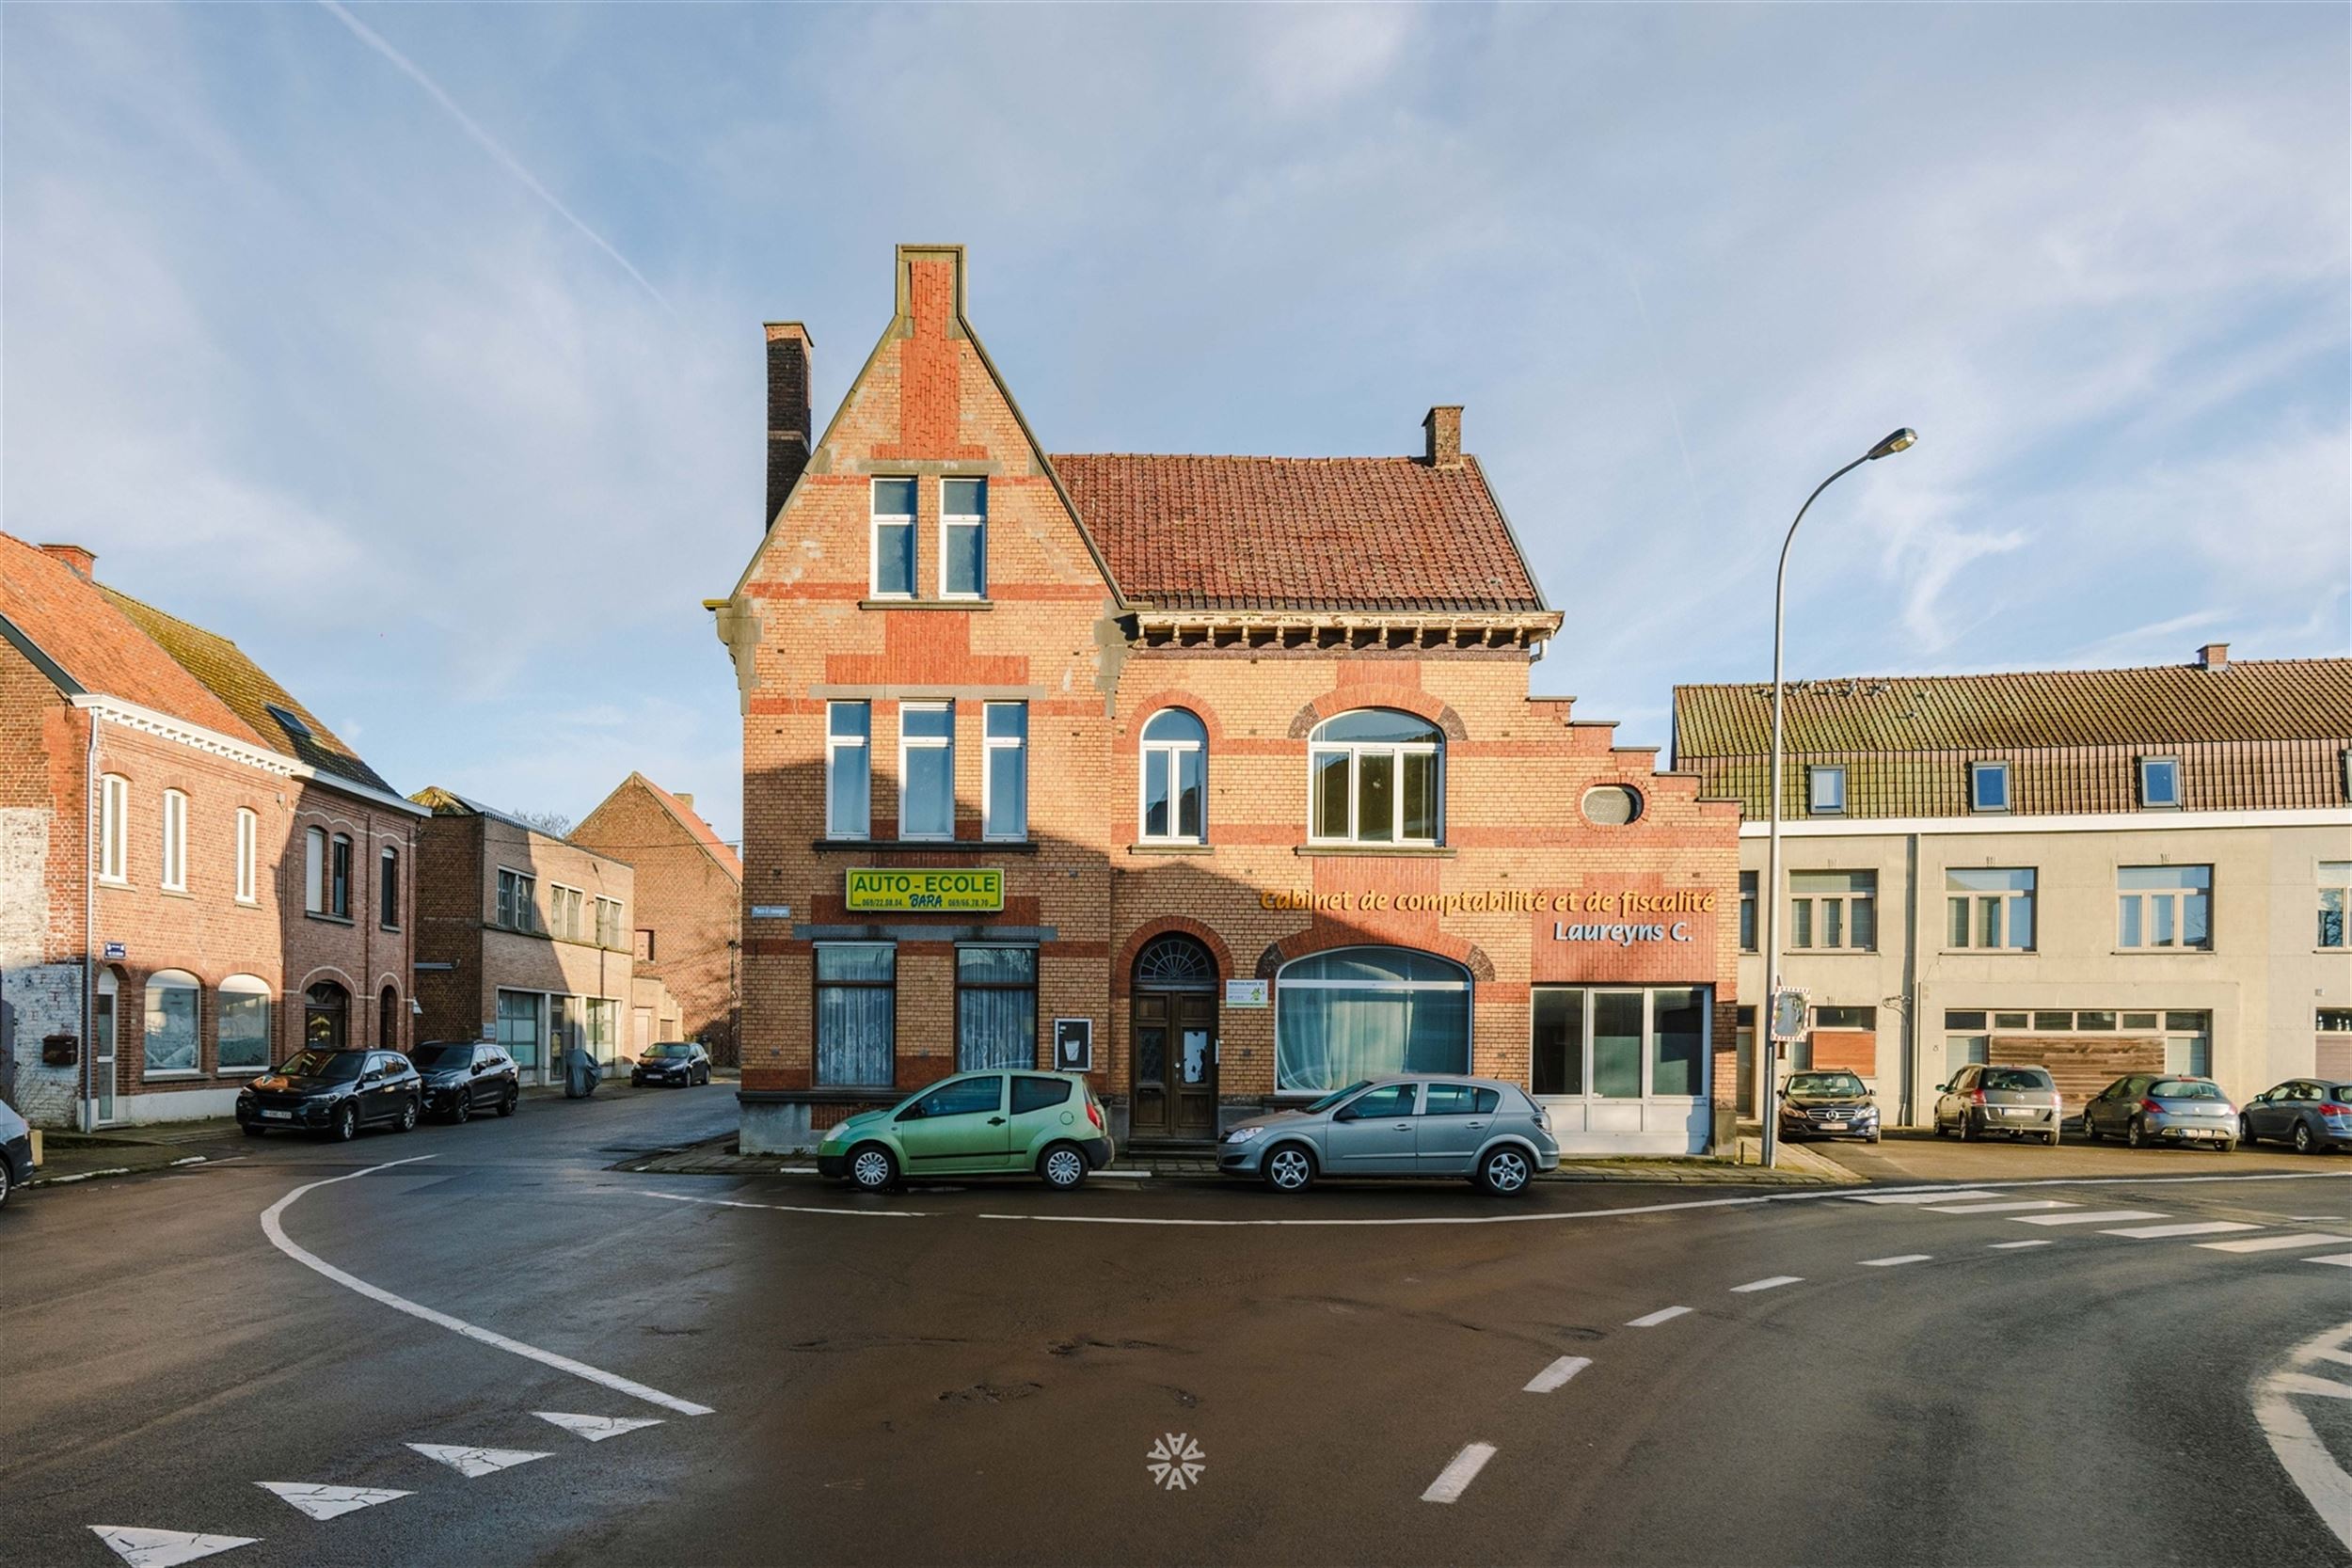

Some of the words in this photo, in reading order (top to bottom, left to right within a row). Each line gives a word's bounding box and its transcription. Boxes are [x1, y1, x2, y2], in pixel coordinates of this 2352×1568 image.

[909, 894, 943, 908] BARA
[1261, 889, 1355, 911] Cabinet
[1359, 890, 1389, 911] de
[1394, 889, 1548, 917] comptabilité
[1553, 892, 1580, 911] et
[1584, 891, 1614, 911] de
[1620, 890, 1716, 918] fiscalité
[1554, 922, 1664, 947] Laureyns
[1671, 922, 1693, 942] C.
